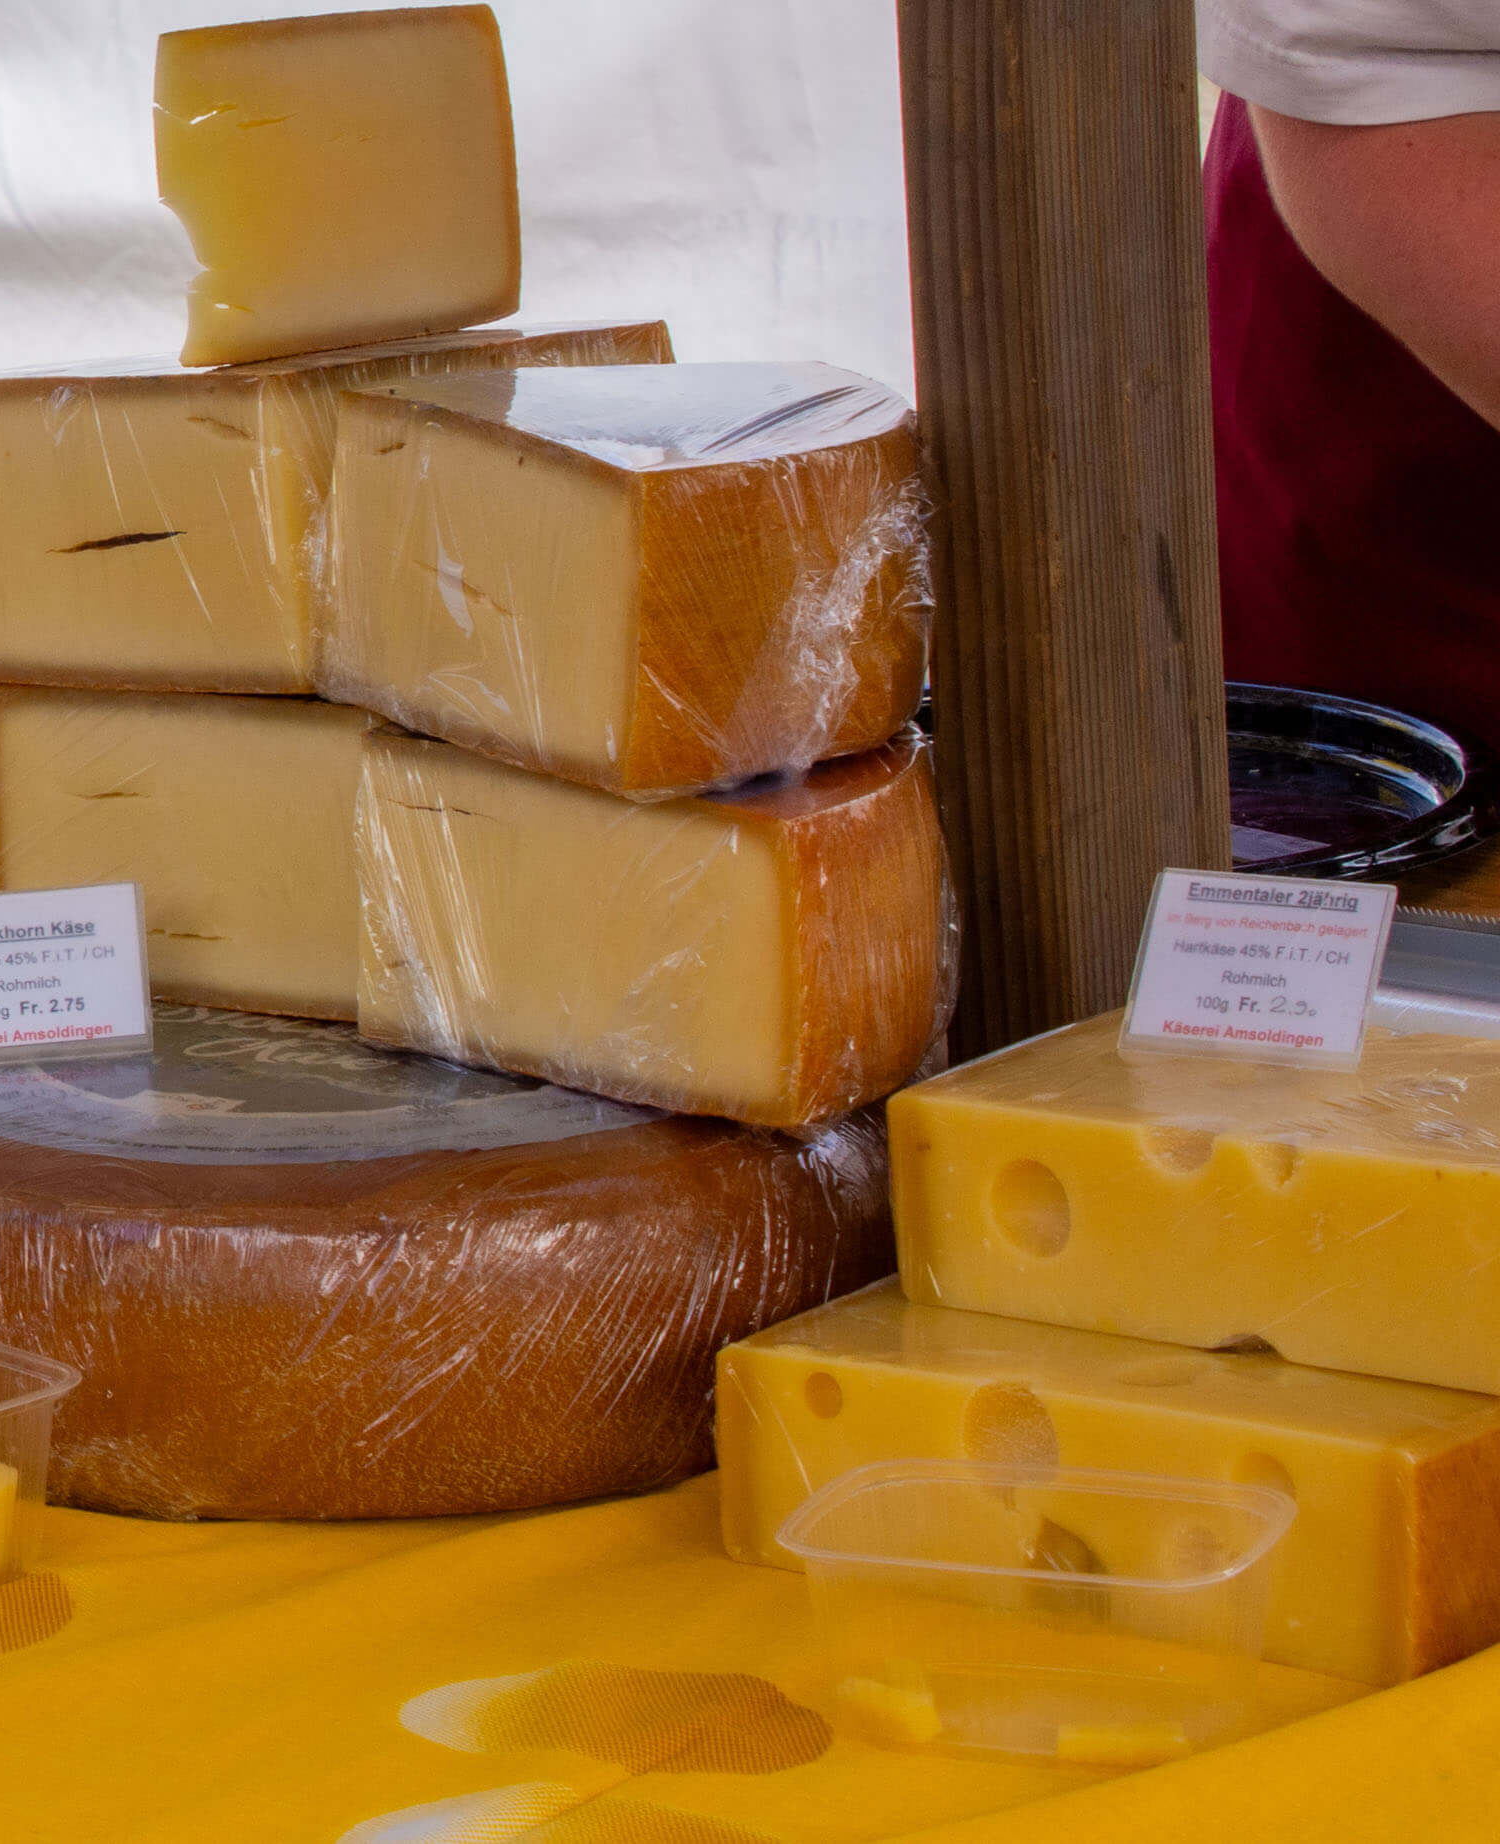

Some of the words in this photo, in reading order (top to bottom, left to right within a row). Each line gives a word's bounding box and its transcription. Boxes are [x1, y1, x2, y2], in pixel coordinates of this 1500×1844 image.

[1188, 882, 1294, 905] Emmentaler
[51, 920, 96, 936] Käse
[1216, 916, 1236, 929] von
[1318, 922, 1369, 939] gelagert
[5, 951, 37, 966] 45%
[91, 945, 115, 960] CH
[1173, 940, 1236, 957] Hartkäse
[1239, 944, 1270, 959] 45%
[1325, 951, 1350, 966] CH
[1221, 970, 1287, 988] Rohmilch
[19, 1000, 43, 1015] Fr.
[49, 997, 86, 1014] 2.75
[1196, 996, 1229, 1015] 100g
[1238, 997, 1260, 1013] Fr.
[12, 1023, 114, 1043] Amsoldingen
[1163, 1020, 1220, 1039] Käserei
[1223, 1023, 1325, 1047] Amsoldingen
